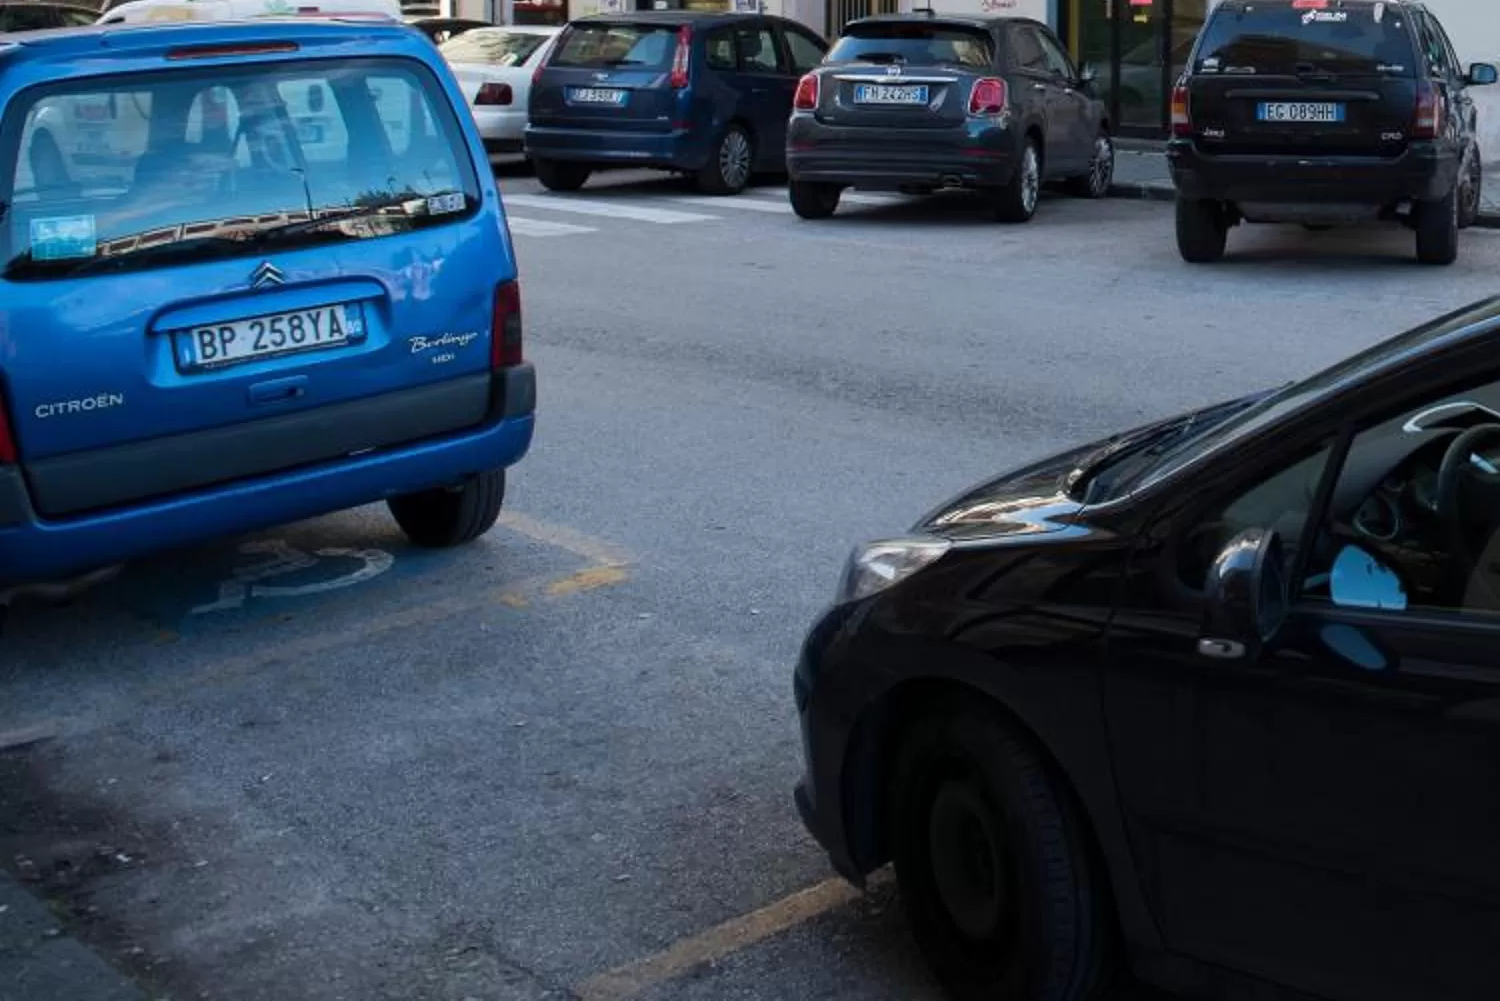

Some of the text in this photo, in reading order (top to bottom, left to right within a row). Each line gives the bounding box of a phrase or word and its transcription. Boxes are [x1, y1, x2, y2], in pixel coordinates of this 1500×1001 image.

[1267, 104, 1336, 120] EG 089HH
[199, 326, 236, 360] BP
[250, 308, 344, 351] 258YA
